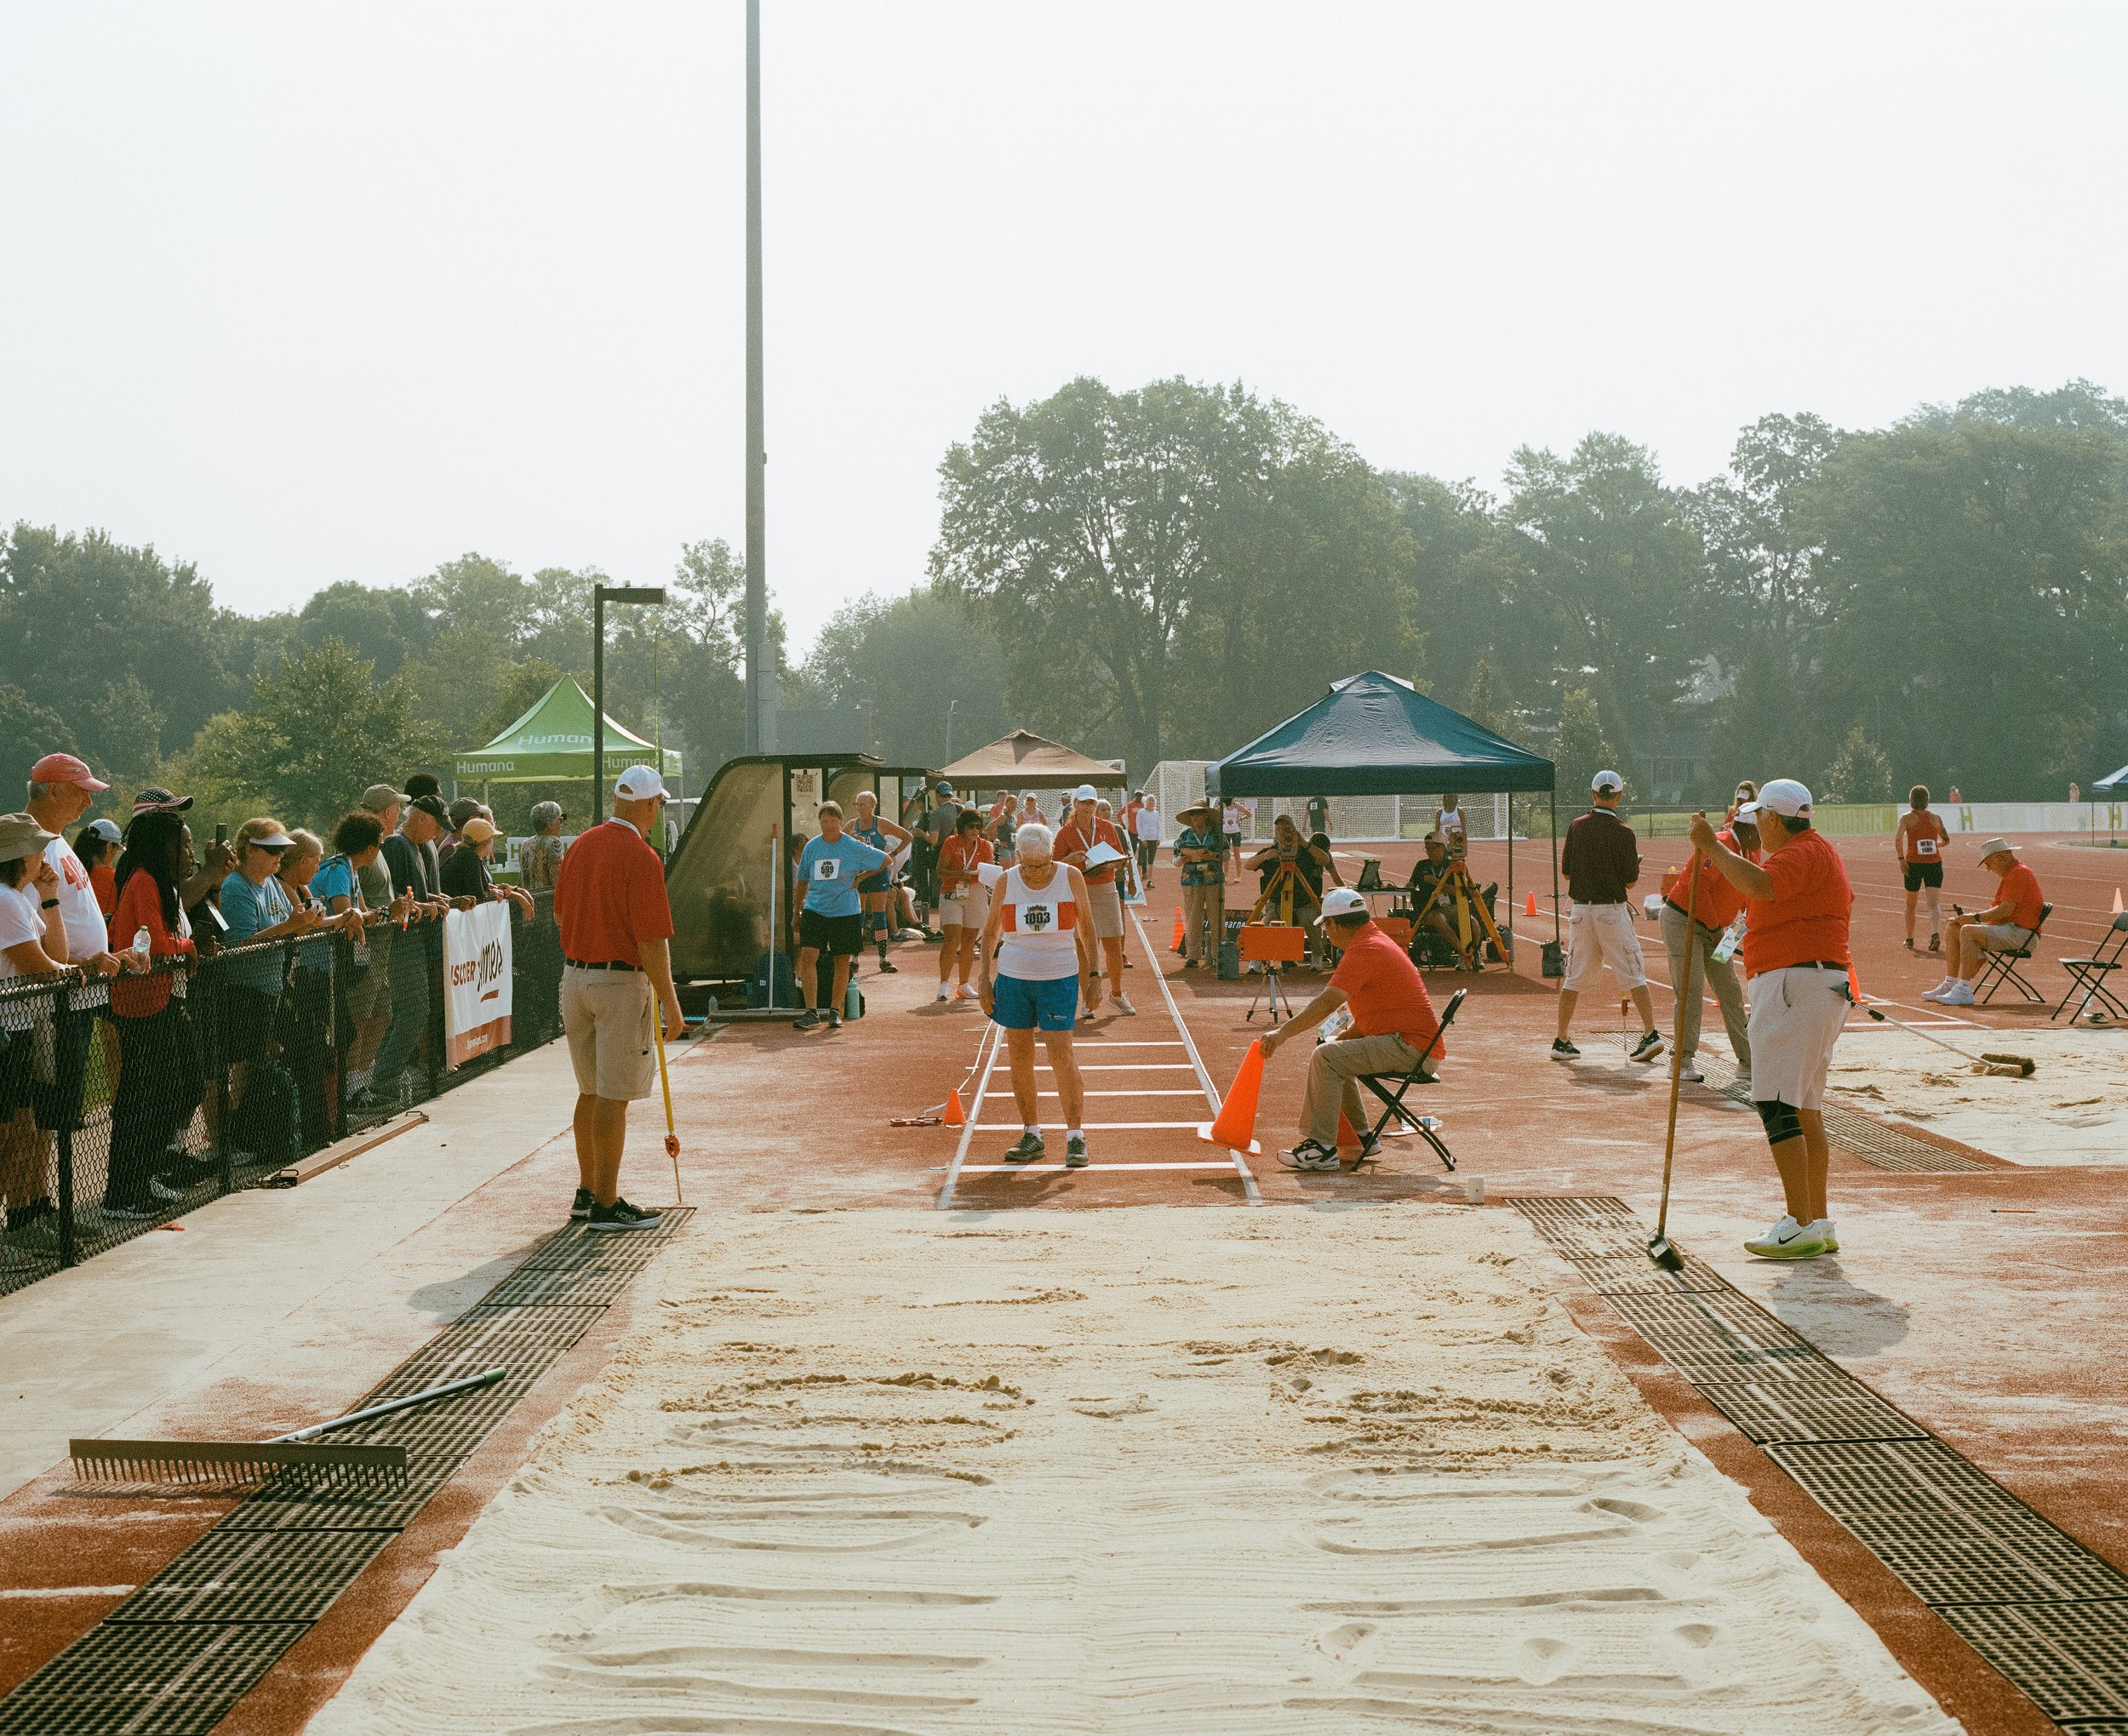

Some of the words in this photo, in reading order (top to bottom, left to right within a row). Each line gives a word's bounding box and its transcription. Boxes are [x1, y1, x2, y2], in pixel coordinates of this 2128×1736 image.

[518, 734, 604, 745] Human
[456, 761, 514, 774] Humana
[1959, 806, 1973, 831] H
[821, 865, 834, 874] 599
[1023, 911, 1051, 925] 1003
